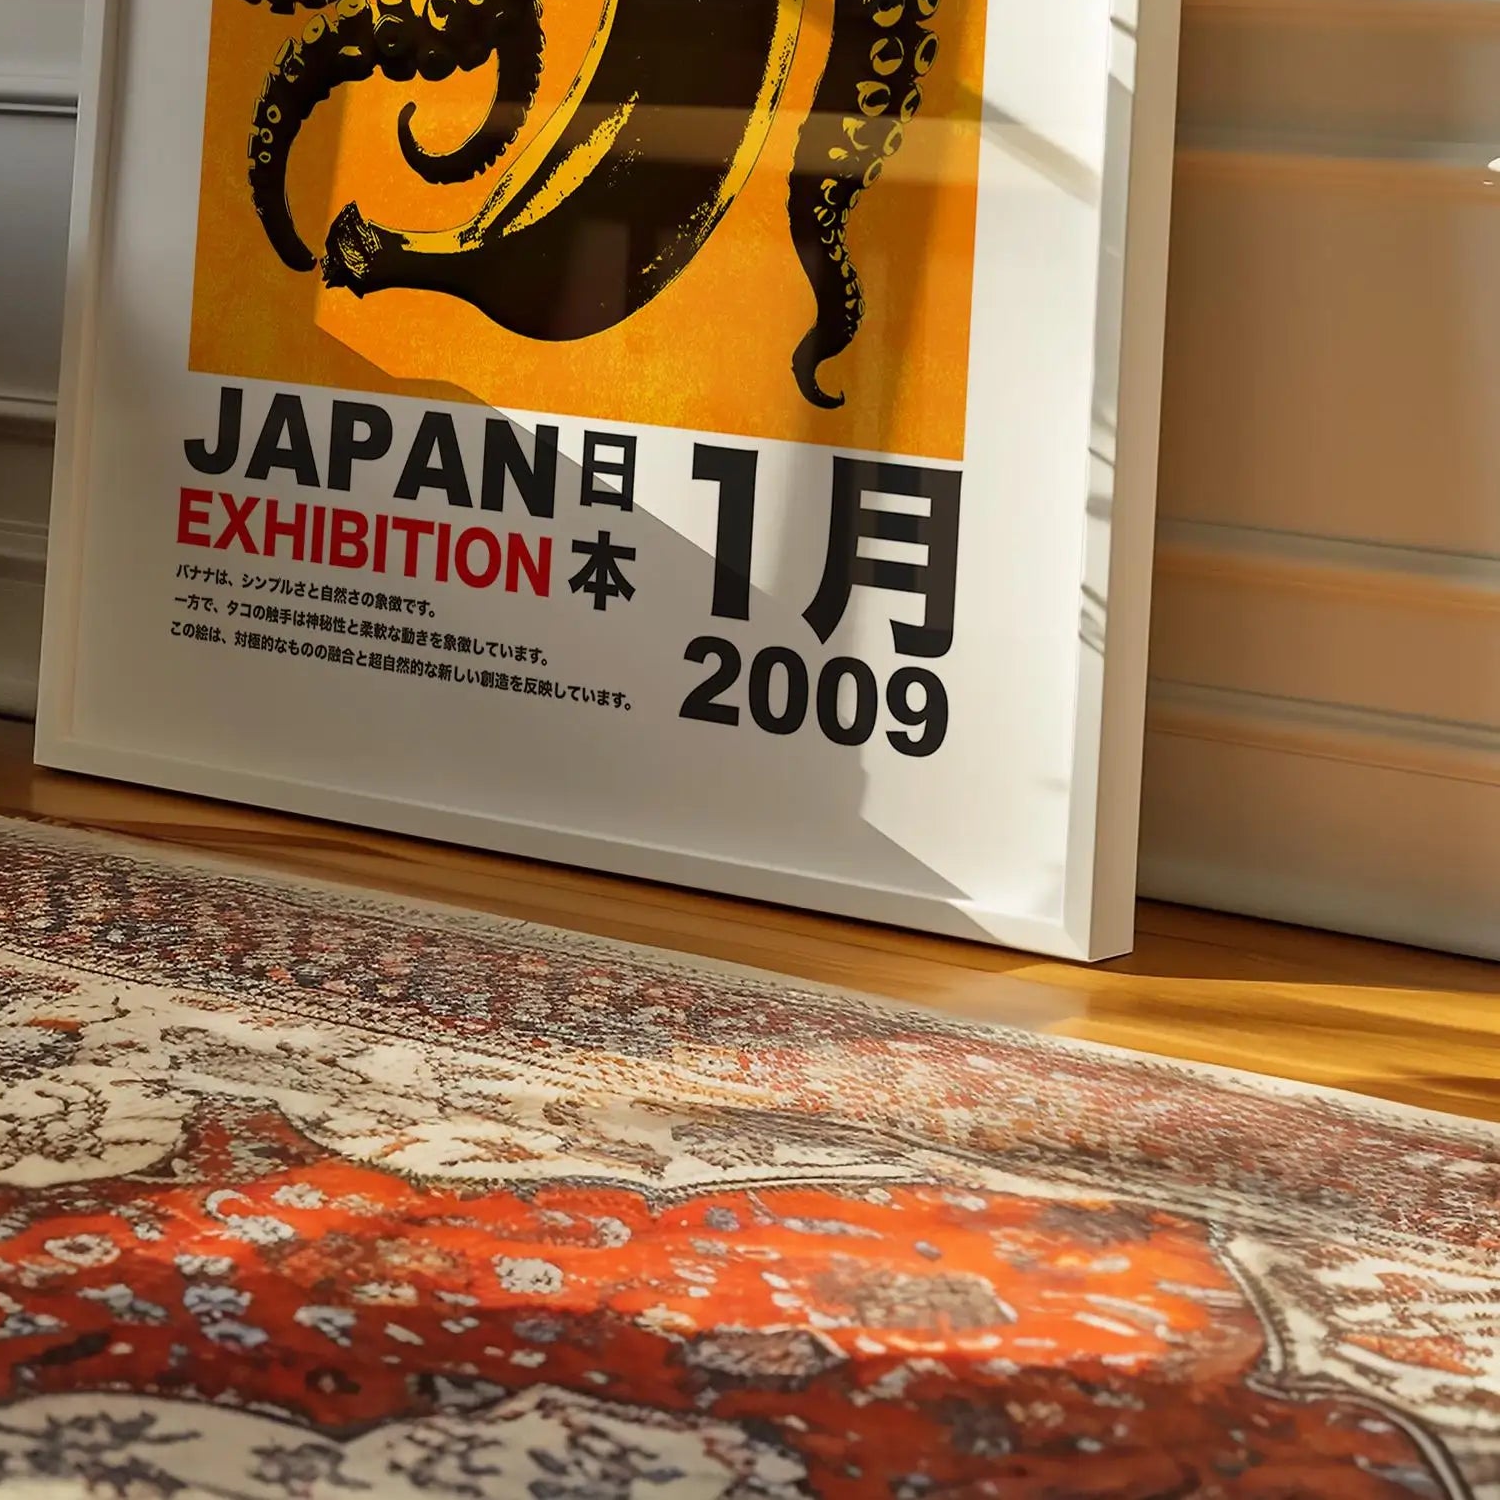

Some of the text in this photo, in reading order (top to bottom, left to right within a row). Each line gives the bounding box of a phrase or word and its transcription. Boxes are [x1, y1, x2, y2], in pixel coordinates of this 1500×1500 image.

[183, 386, 559, 519] JAPAN
[176, 487, 553, 598] EXHIBITION
[678, 635, 950, 758] 2009
